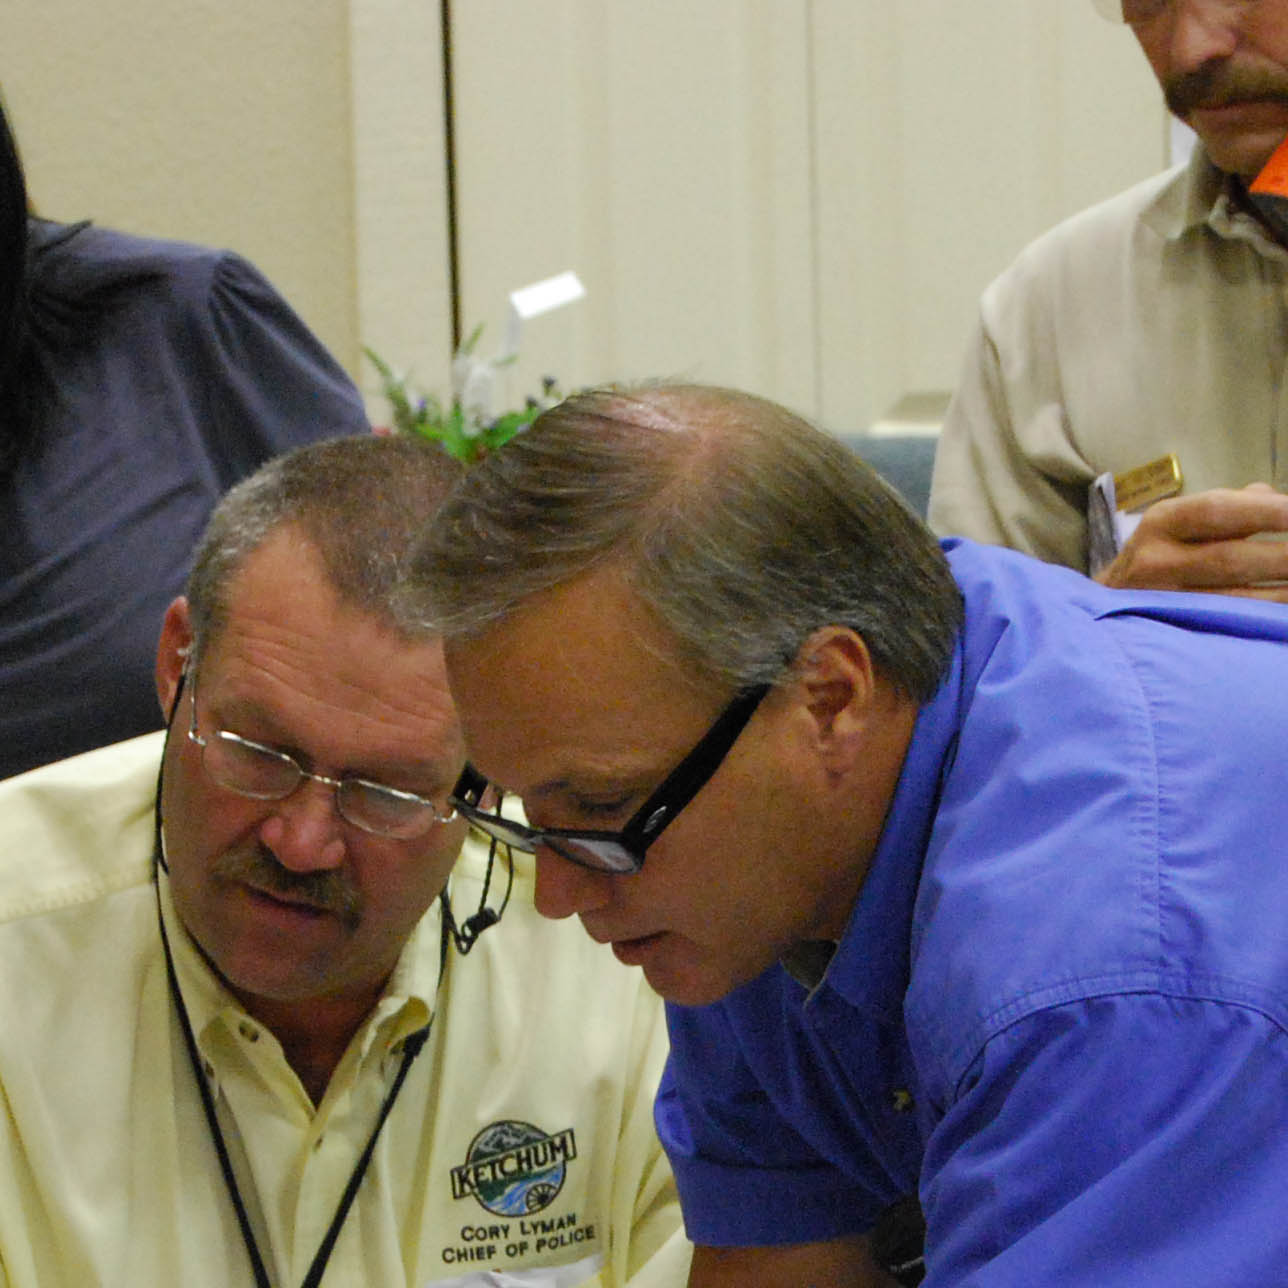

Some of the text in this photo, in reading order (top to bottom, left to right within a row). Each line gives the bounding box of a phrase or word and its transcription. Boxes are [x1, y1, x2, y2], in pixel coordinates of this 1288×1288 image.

[456, 1134, 569, 1195] KETCHUM
[441, 1224, 596, 1264] CHIEF OF POLICE
[461, 1212, 577, 1242] CORY LYMAN
